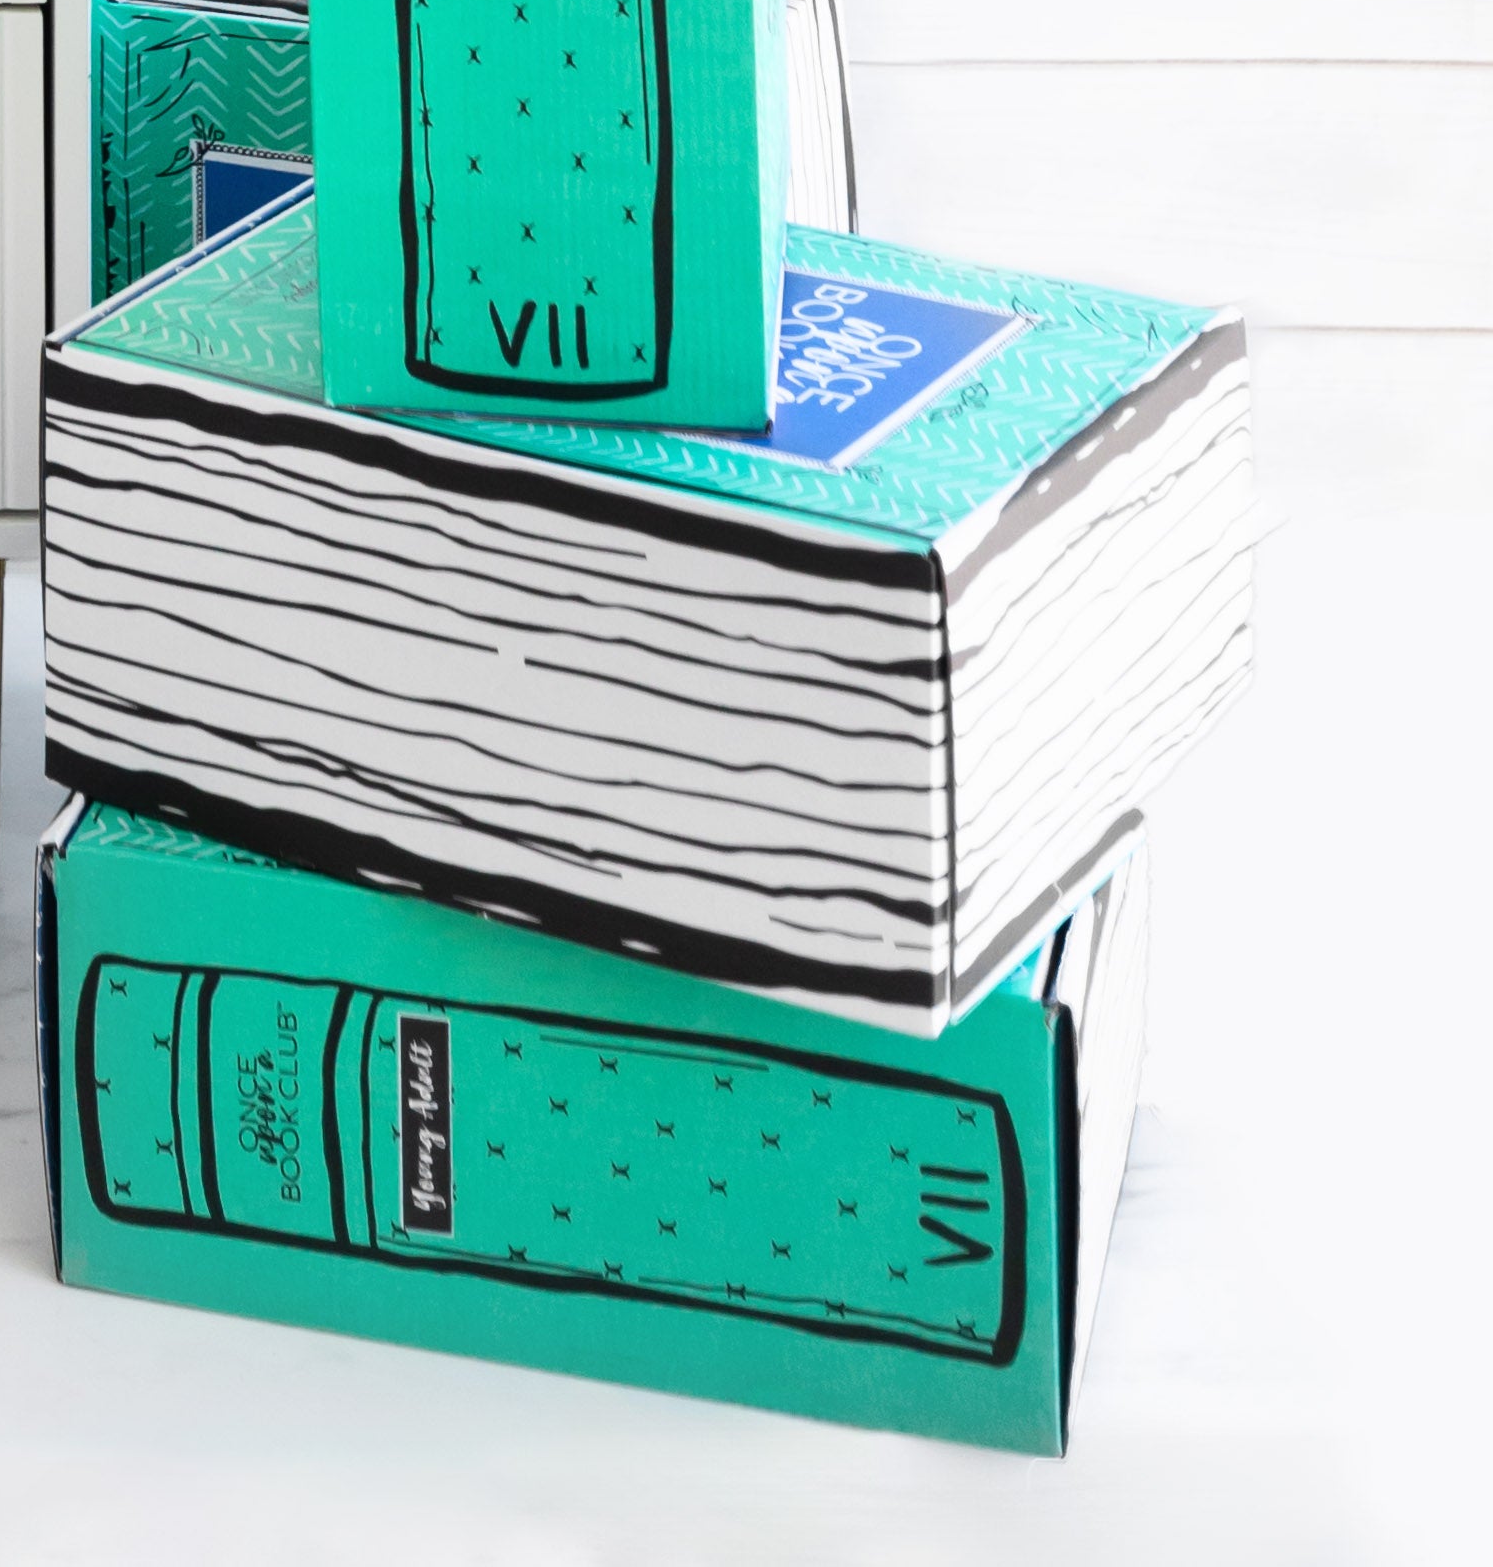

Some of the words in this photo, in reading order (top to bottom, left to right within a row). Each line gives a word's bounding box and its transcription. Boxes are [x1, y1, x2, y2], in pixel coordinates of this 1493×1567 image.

[489, 299, 589, 369] VII
[779, 283, 868, 362] BOO
[797, 334, 922, 414] ONCE
[237, 1053, 259, 1153] ONCE
[408, 1039, 439, 1120] Adult
[280, 1105, 301, 1203] BOOK
[411, 1123, 447, 1212] Young
[919, 1166, 994, 1266] VII
